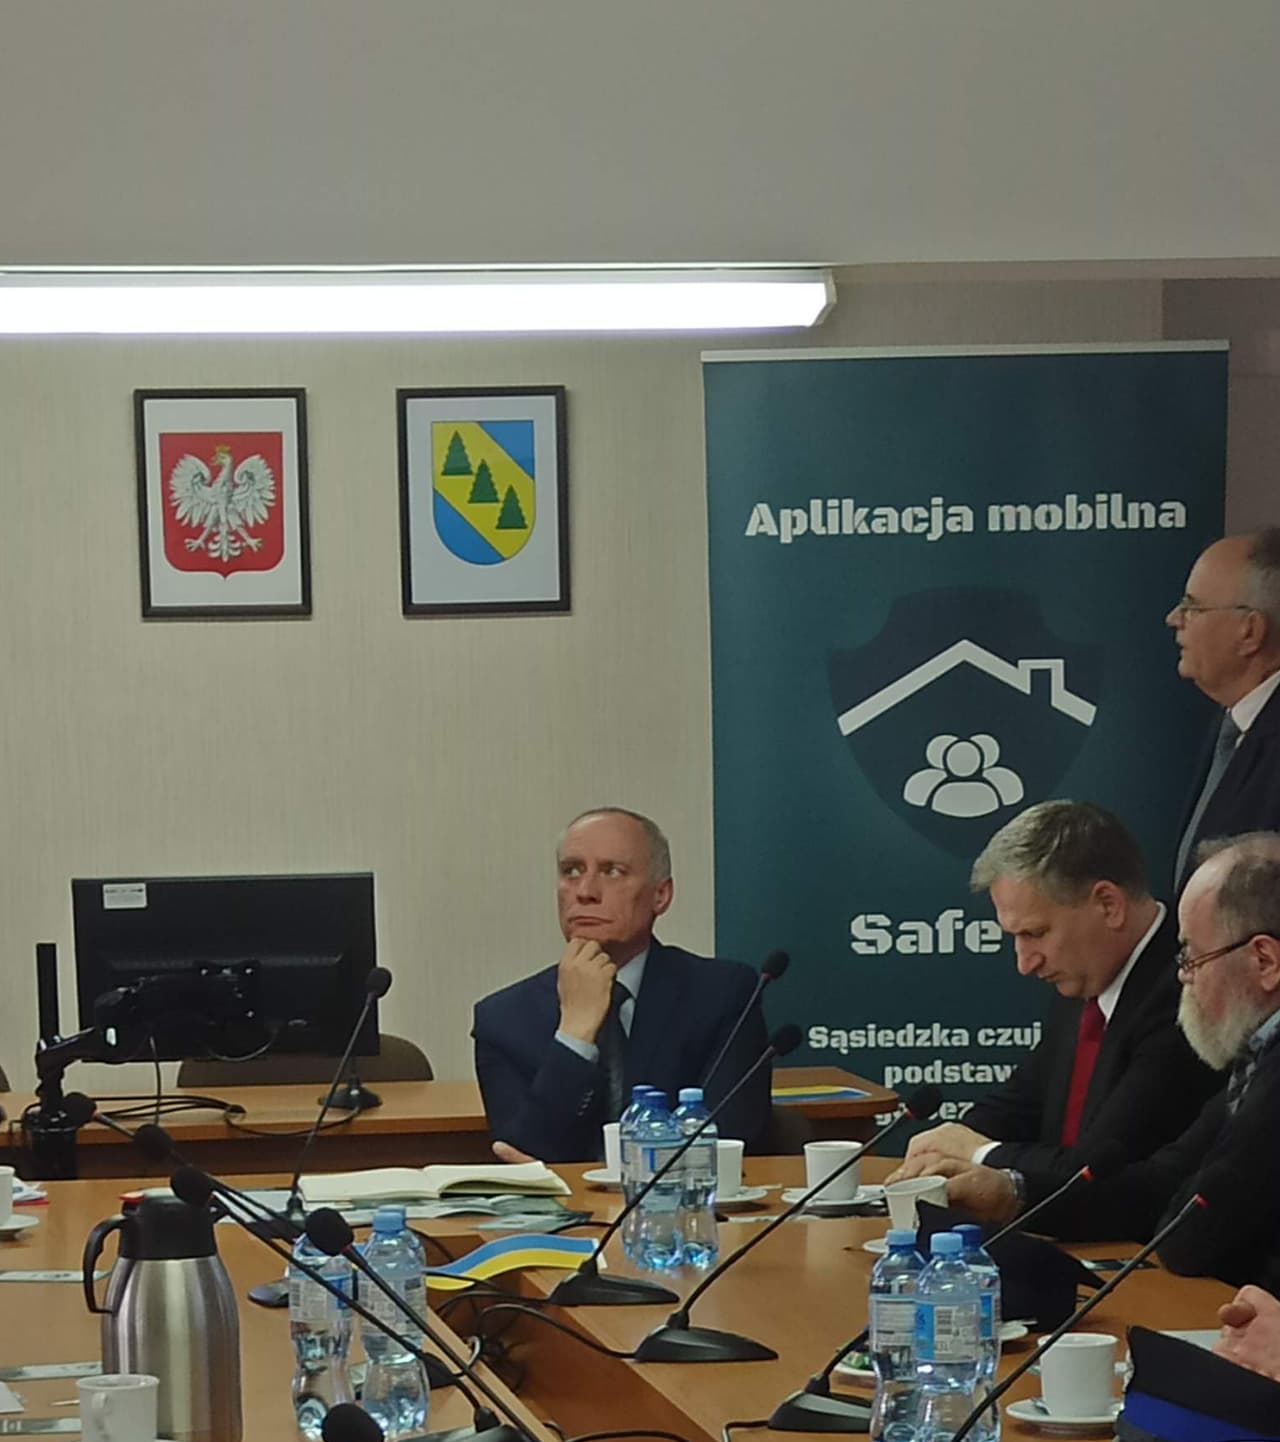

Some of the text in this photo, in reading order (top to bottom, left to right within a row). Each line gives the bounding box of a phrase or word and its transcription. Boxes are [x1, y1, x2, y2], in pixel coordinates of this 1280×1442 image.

[745, 493, 1186, 543] Aplikacja mobilna
[850, 909, 1002, 955] Safe
[808, 1023, 969, 1054] Sąsiedzka
